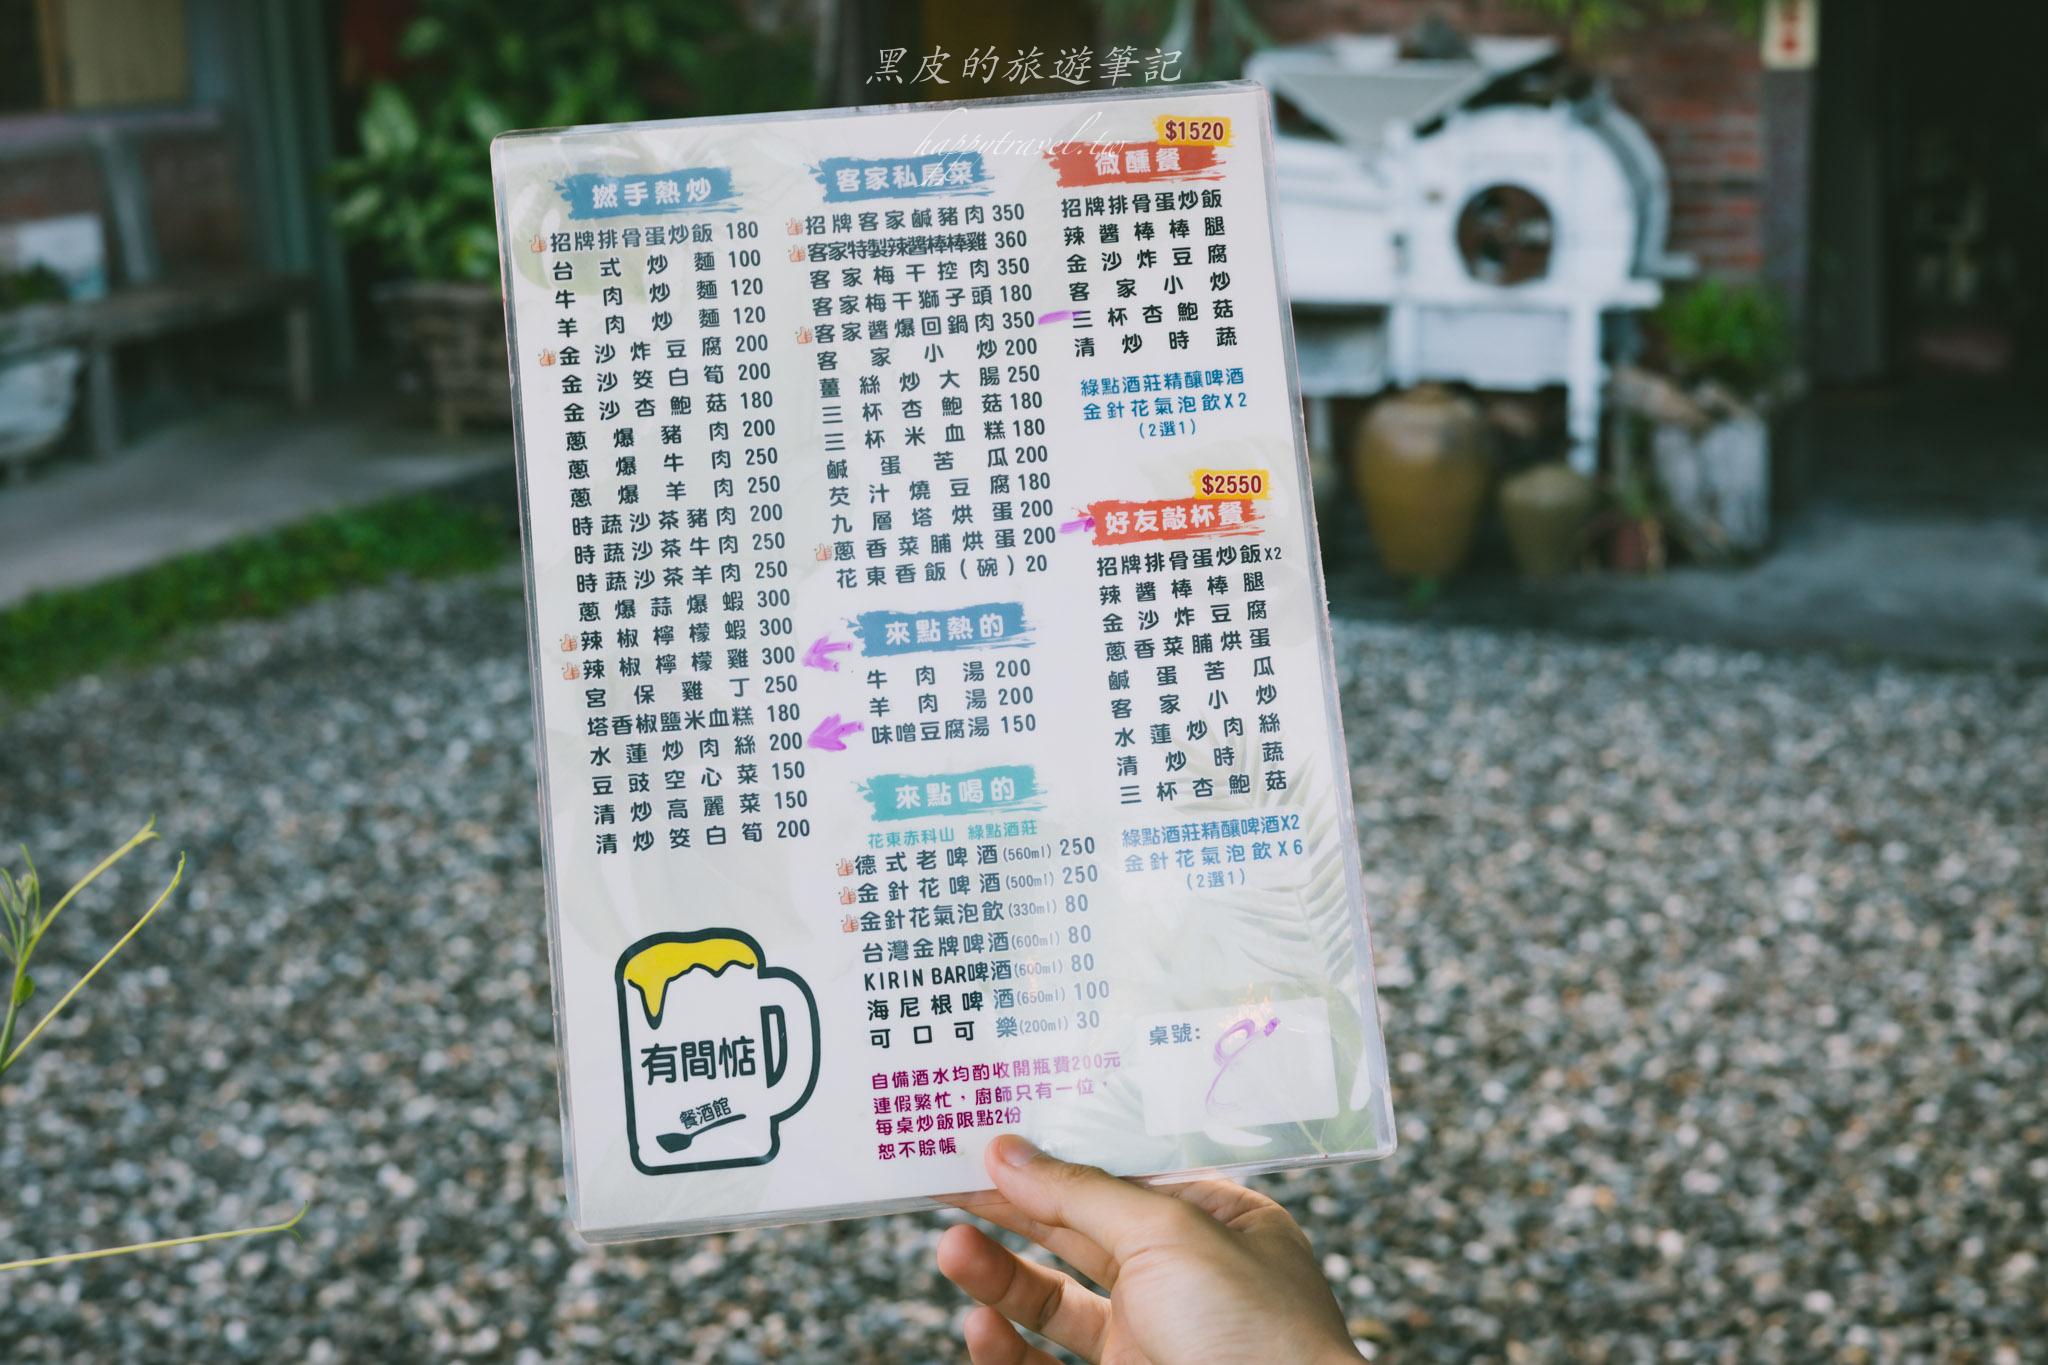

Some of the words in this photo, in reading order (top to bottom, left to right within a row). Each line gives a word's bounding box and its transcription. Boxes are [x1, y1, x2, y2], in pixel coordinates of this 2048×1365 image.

[1165, 120, 1224, 140] $1520
[1095, 148, 1181, 176] 微醺餐
[836, 161, 973, 193] 客家私房菜
[992, 203, 1024, 222] 350
[726, 221, 758, 240] 180
[995, 230, 1027, 249] 360
[728, 249, 761, 268] 100
[997, 257, 1029, 276] 350
[731, 278, 763, 296] 120
[1000, 284, 1032, 302] 180
[733, 306, 766, 324] 120
[1002, 311, 1034, 329] 350
[735, 334, 768, 352] 200
[1005, 337, 1037, 356] 200
[738, 362, 770, 381] 200
[1008, 364, 1040, 383] 250
[740, 391, 773, 409] 180
[1010, 391, 1042, 410] 180
[743, 419, 775, 437] 200
[1013, 418, 1045, 437] 180
[745, 447, 778, 466] 250
[1015, 445, 1048, 464] 200
[747, 475, 780, 494] 250
[1018, 472, 1050, 491] 180
[1202, 474, 1262, 495] $2550
[750, 503, 783, 522] 200
[1020, 499, 1053, 518] 200
[1105, 501, 1244, 535] 好友敲杯餐
[752, 532, 785, 551] 250
[1023, 526, 1056, 545] 200
[755, 560, 787, 579] 250
[1026, 554, 1047, 572] 20
[757, 589, 790, 608] 300
[759, 617, 792, 636] 300
[885, 613, 1004, 646] 來點熱的
[762, 646, 795, 665] 300
[995, 659, 1030, 678] 200
[764, 674, 797, 693] 250
[998, 686, 1033, 706] 200
[767, 703, 800, 722] 180
[1001, 714, 1036, 733] 150
[769, 732, 802, 751] 200
[772, 761, 805, 780] 150
[774, 790, 807, 809] 150
[896, 777, 1015, 809] 來點喝的
[777, 819, 810, 838] 200
[1059, 833, 1096, 857] 250
[1062, 863, 1098, 885] 250
[1065, 893, 1088, 913] 80
[1068, 924, 1092, 944] 80
[864, 968, 923, 991] KIRIN
[1071, 952, 1094, 973] 80
[1073, 980, 1109, 1001] 100
[1076, 1009, 1100, 1029] 30
[679, 1097, 732, 1129] 餐酒館
